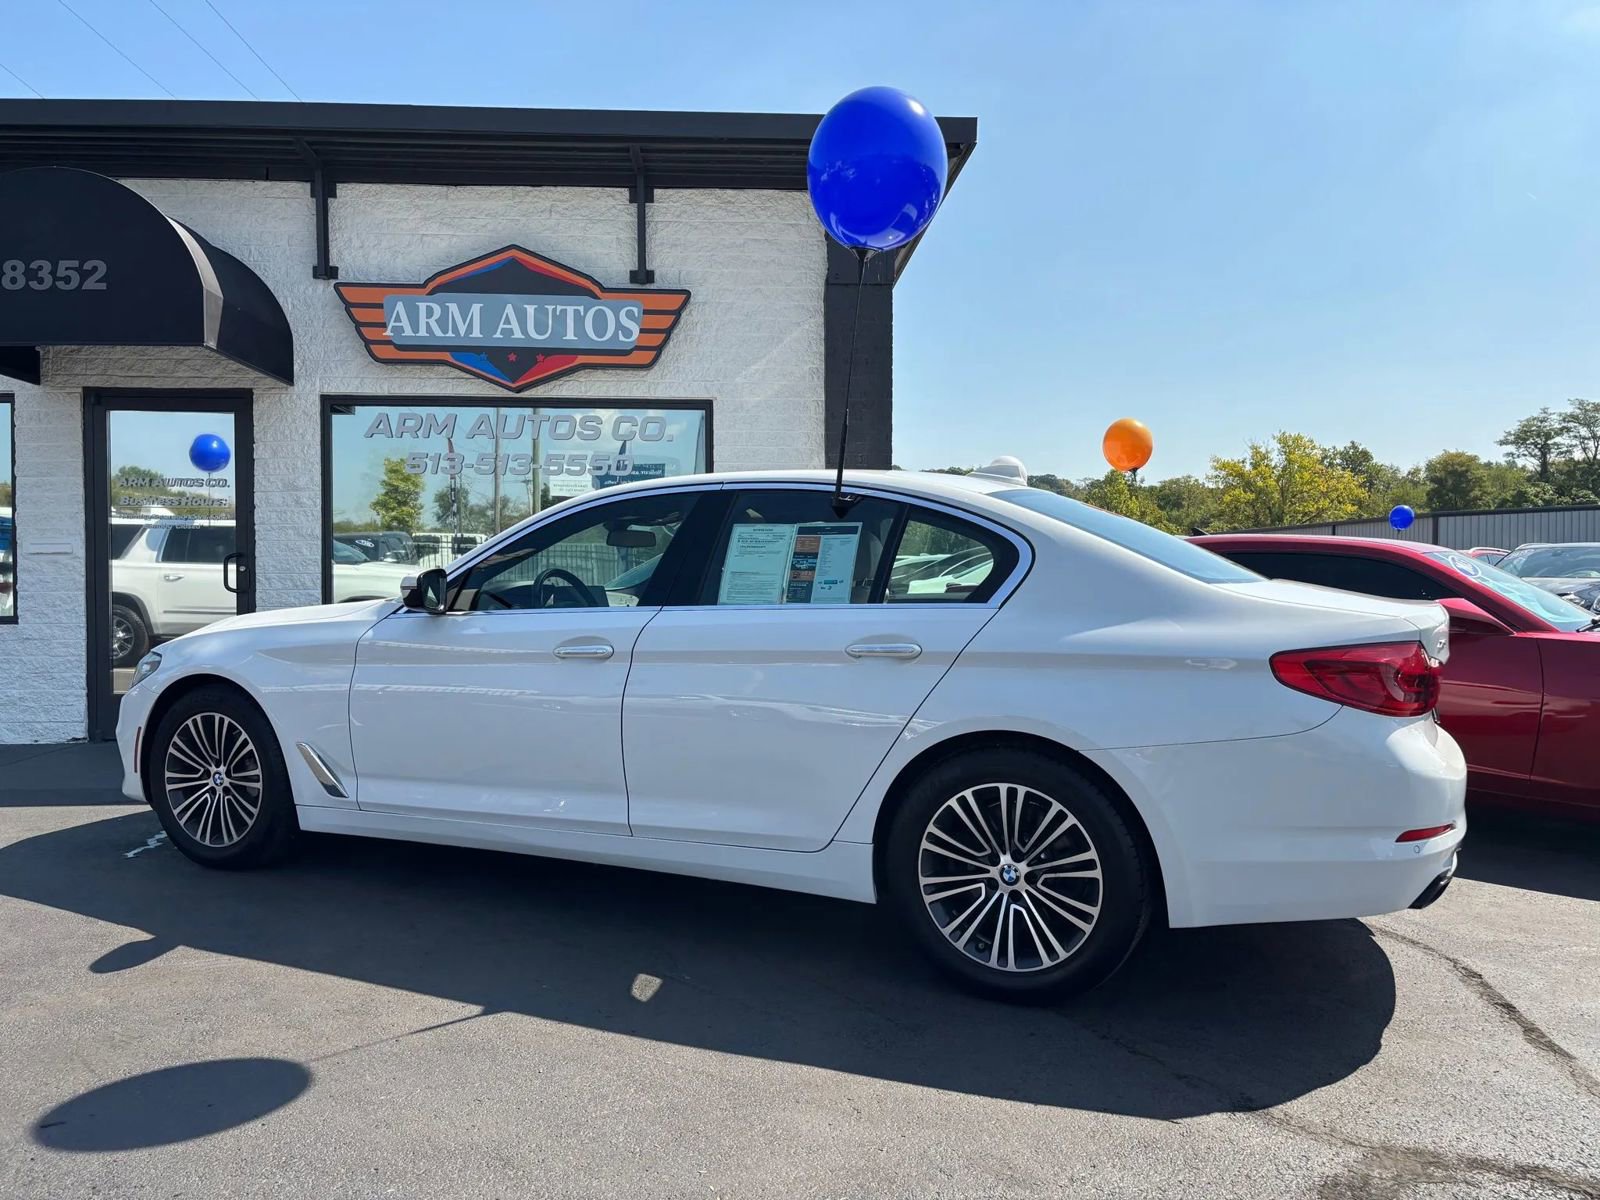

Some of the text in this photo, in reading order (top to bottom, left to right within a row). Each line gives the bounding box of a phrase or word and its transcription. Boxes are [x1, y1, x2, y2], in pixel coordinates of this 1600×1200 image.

[1, 259, 107, 290] 8352
[383, 301, 641, 342] ARM AUTOS
[364, 412, 674, 442] ARM AUTOS CO.
[405, 452, 635, 477] 513-513-5550
[119, 478, 231, 488] ARM AUTOS CO.
[120, 496, 181, 506] Business
